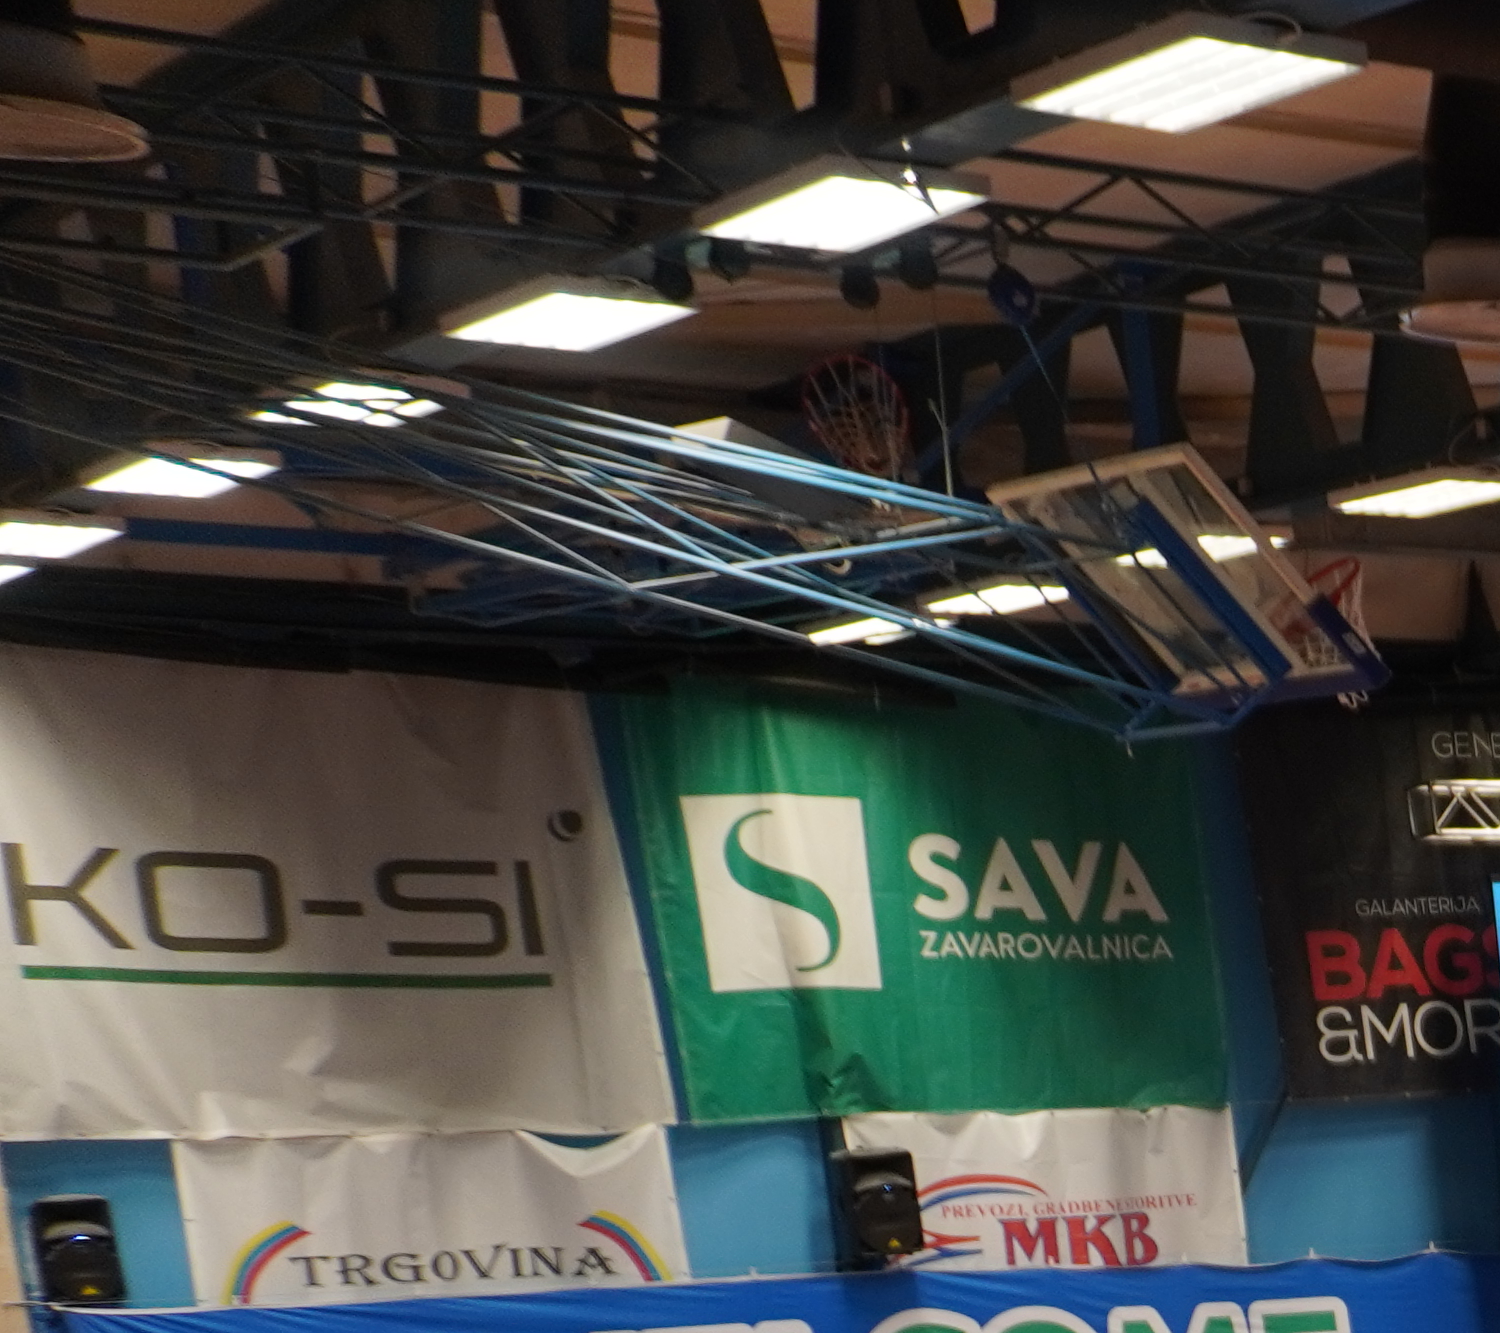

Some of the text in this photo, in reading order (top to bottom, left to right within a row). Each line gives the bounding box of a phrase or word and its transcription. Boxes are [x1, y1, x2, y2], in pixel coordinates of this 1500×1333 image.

[1, 843, 545, 957] KO-SI
[909, 834, 1168, 922] SAVA
[1356, 898, 1480, 916] GALANTERIJA
[920, 930, 1173, 960] ZAVAROVALNICA
[1000, 1211, 1159, 1266] MKB
[289, 1244, 617, 1288] TRGOVINA
